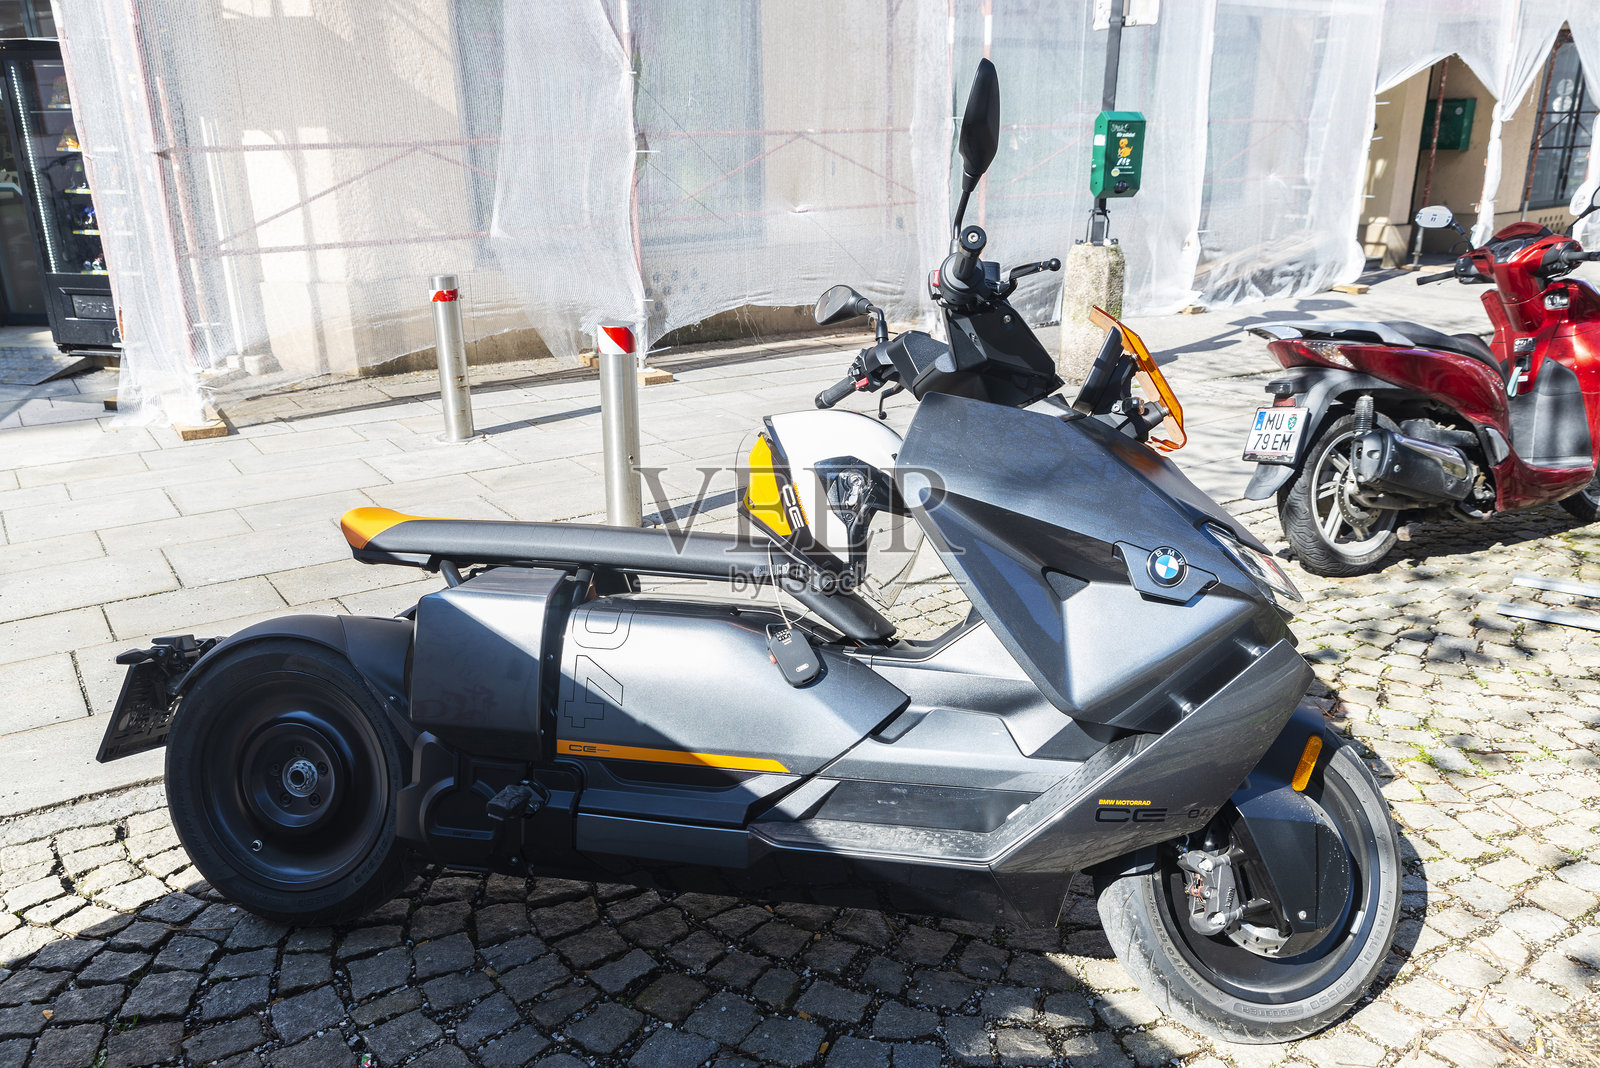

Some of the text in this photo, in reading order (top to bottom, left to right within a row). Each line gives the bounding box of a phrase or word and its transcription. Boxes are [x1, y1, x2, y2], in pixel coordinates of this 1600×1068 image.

[1265, 414, 1284, 430] MU
[1254, 434, 1292, 451] 79 EM
